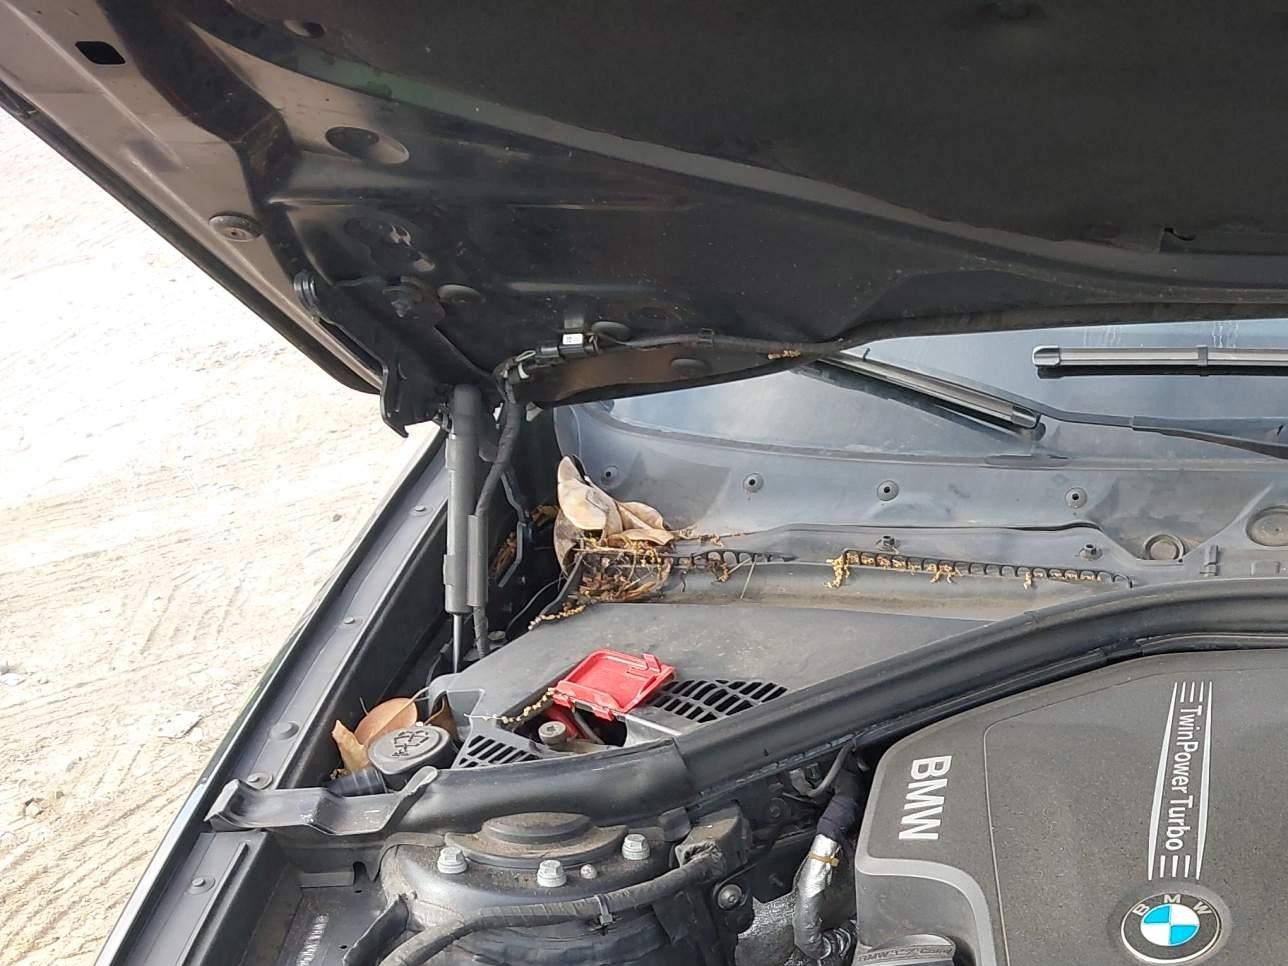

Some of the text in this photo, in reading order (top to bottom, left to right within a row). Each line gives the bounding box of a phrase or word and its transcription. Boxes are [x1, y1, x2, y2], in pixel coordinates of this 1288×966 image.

[898, 755, 952, 840] BMW
[1165, 705, 1203, 851] TwinPower Turbo
[1132, 893, 1212, 917] BMW
